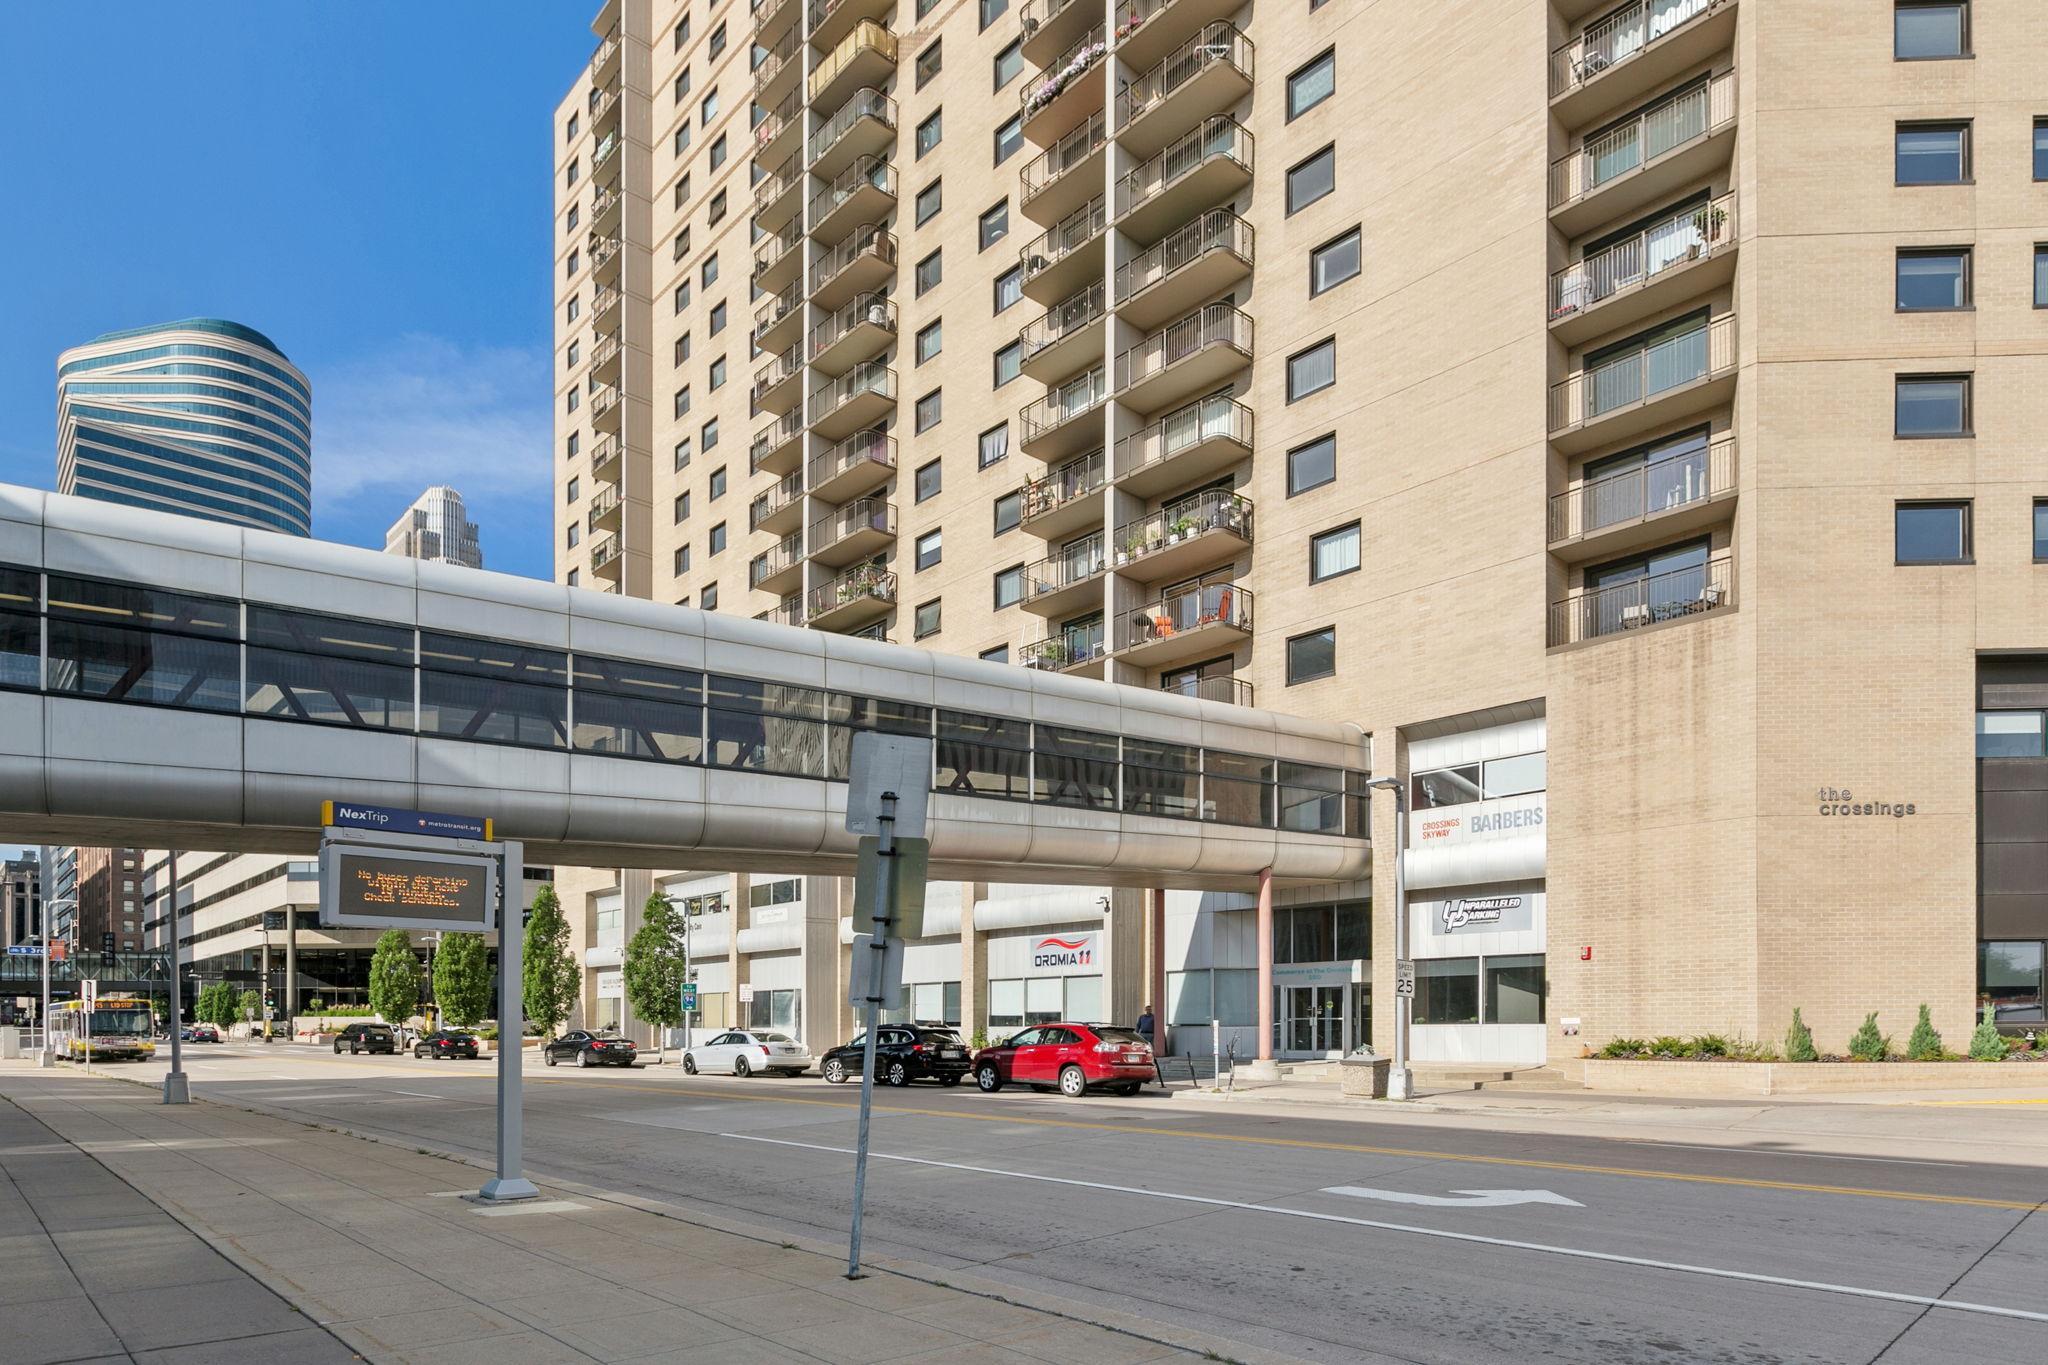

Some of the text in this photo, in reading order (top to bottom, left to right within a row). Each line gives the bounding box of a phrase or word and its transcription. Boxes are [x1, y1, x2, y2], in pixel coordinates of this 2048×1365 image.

[1819, 787, 1852, 801] the
[339, 807, 389, 824] NexTrip
[1819, 801, 1916, 818] crossings
[428, 820, 482, 832] metrotransit.org
[1422, 818, 1460, 831] CROSSINGS
[1470, 807, 1544, 833] BARBERS
[1422, 829, 1450, 840] SKYWAY
[358, 870, 372, 879] No
[377, 872, 409, 882] buses
[364, 892, 396, 903] Check
[1034, 950, 1091, 967] OROMIA 11
[1398, 979, 1413, 993] 25
